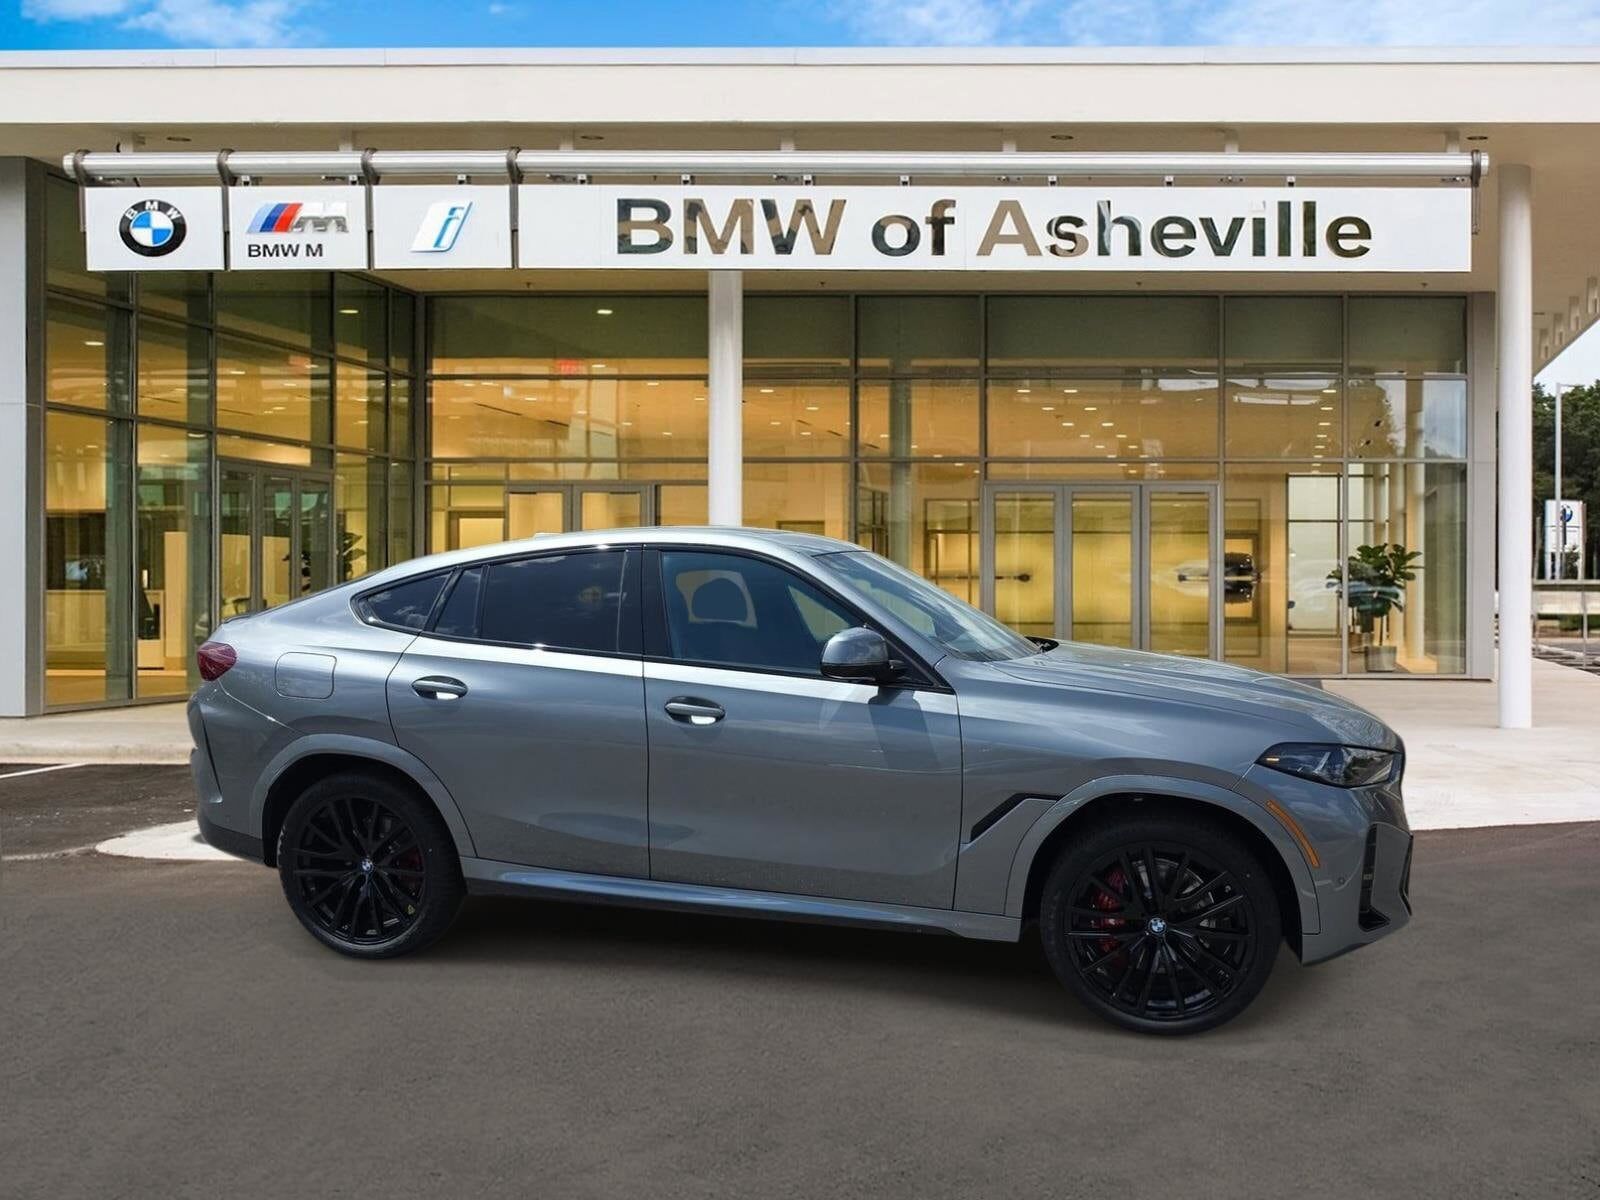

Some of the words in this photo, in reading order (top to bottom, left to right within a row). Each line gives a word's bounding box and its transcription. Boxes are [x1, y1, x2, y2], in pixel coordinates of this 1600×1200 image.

[124, 201, 181, 221] BMW
[617, 198, 847, 256] BMW
[871, 199, 956, 257] of
[976, 200, 1372, 258] Asheville
[248, 244, 301, 258] BMW
[305, 244, 324, 258] M
